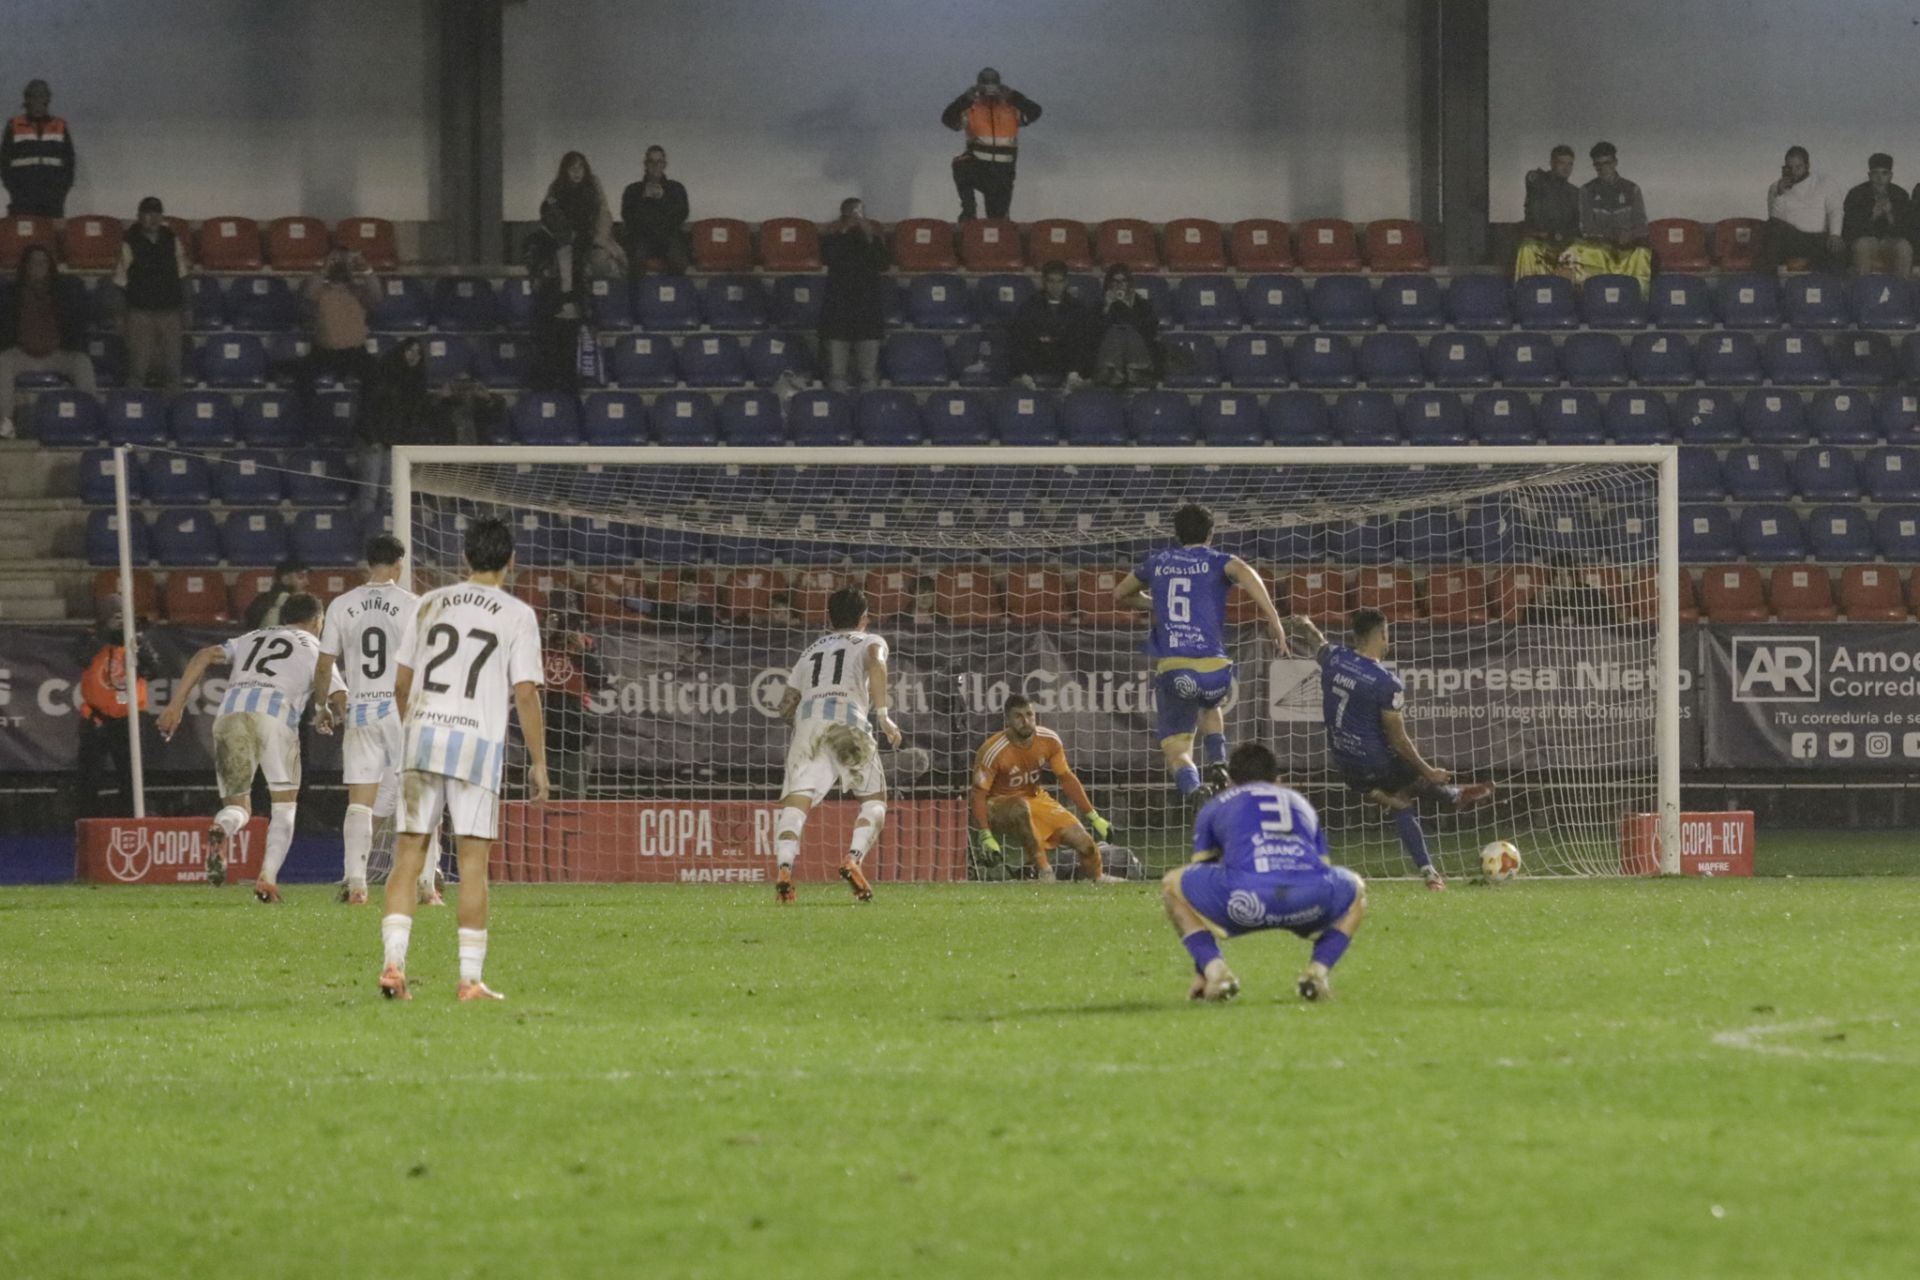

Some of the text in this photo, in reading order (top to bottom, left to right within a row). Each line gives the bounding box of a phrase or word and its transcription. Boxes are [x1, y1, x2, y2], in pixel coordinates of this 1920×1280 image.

[347, 597, 400, 618] F. VIÑAS
[441, 593, 503, 617] AGUDÍN
[1167, 577, 1191, 623] 6
[241, 636, 294, 677] 12
[361, 626, 387, 680] 9
[422, 622, 499, 700] 27
[809, 648, 846, 688] 11
[1739, 646, 1815, 692] AR
[588, 671, 739, 714] Galicia
[1021, 669, 1159, 713] Galici
[1382, 660, 1558, 698] mpresa
[1829, 675, 1920, 697] Corred
[427, 712, 480, 729] HYUNDAI
[1331, 685, 1350, 729] 7
[1802, 711, 1879, 725] correduría
[1884, 711, 1903, 725] de
[1251, 787, 1293, 832] 3
[153, 831, 201, 865] COPA
[639, 808, 713, 857] COPA
[1682, 821, 1744, 856] COPA REY
[681, 868, 765, 882] MAPFRE
